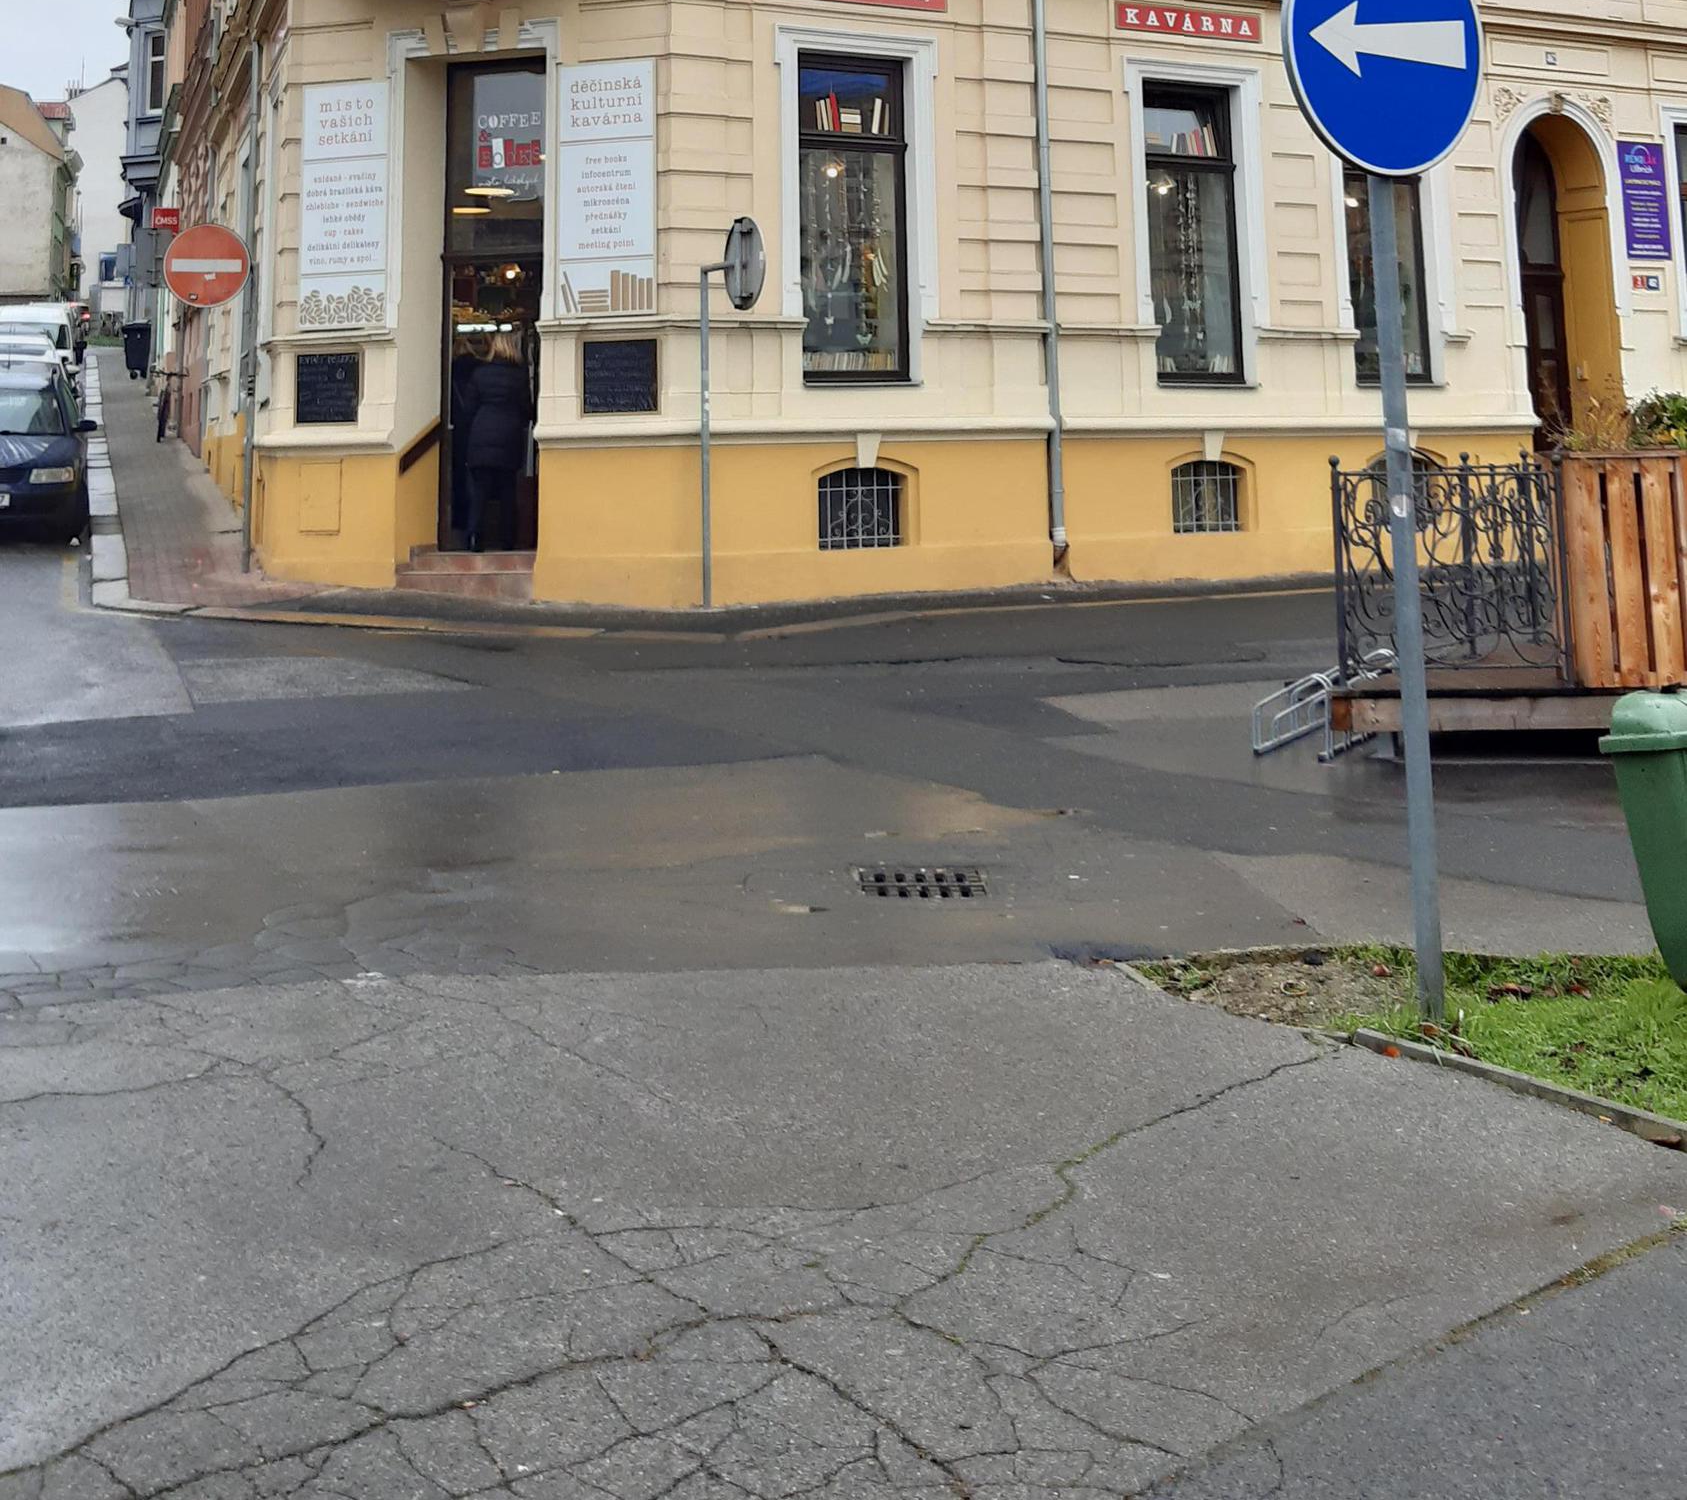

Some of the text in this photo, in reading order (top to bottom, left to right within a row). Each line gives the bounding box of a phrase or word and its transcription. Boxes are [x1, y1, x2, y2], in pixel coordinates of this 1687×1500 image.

[1125, 8, 1253, 36] KAVÁRNA
[570, 75, 642, 94] děčínská
[570, 93, 642, 111] kulturní
[319, 113, 373, 129] vašich
[478, 111, 541, 129] COFFEE
[570, 112, 643, 128] kavárna
[585, 154, 628, 165] free books
[581, 169, 632, 180] infocentrum
[578, 239, 635, 250] meeting point
